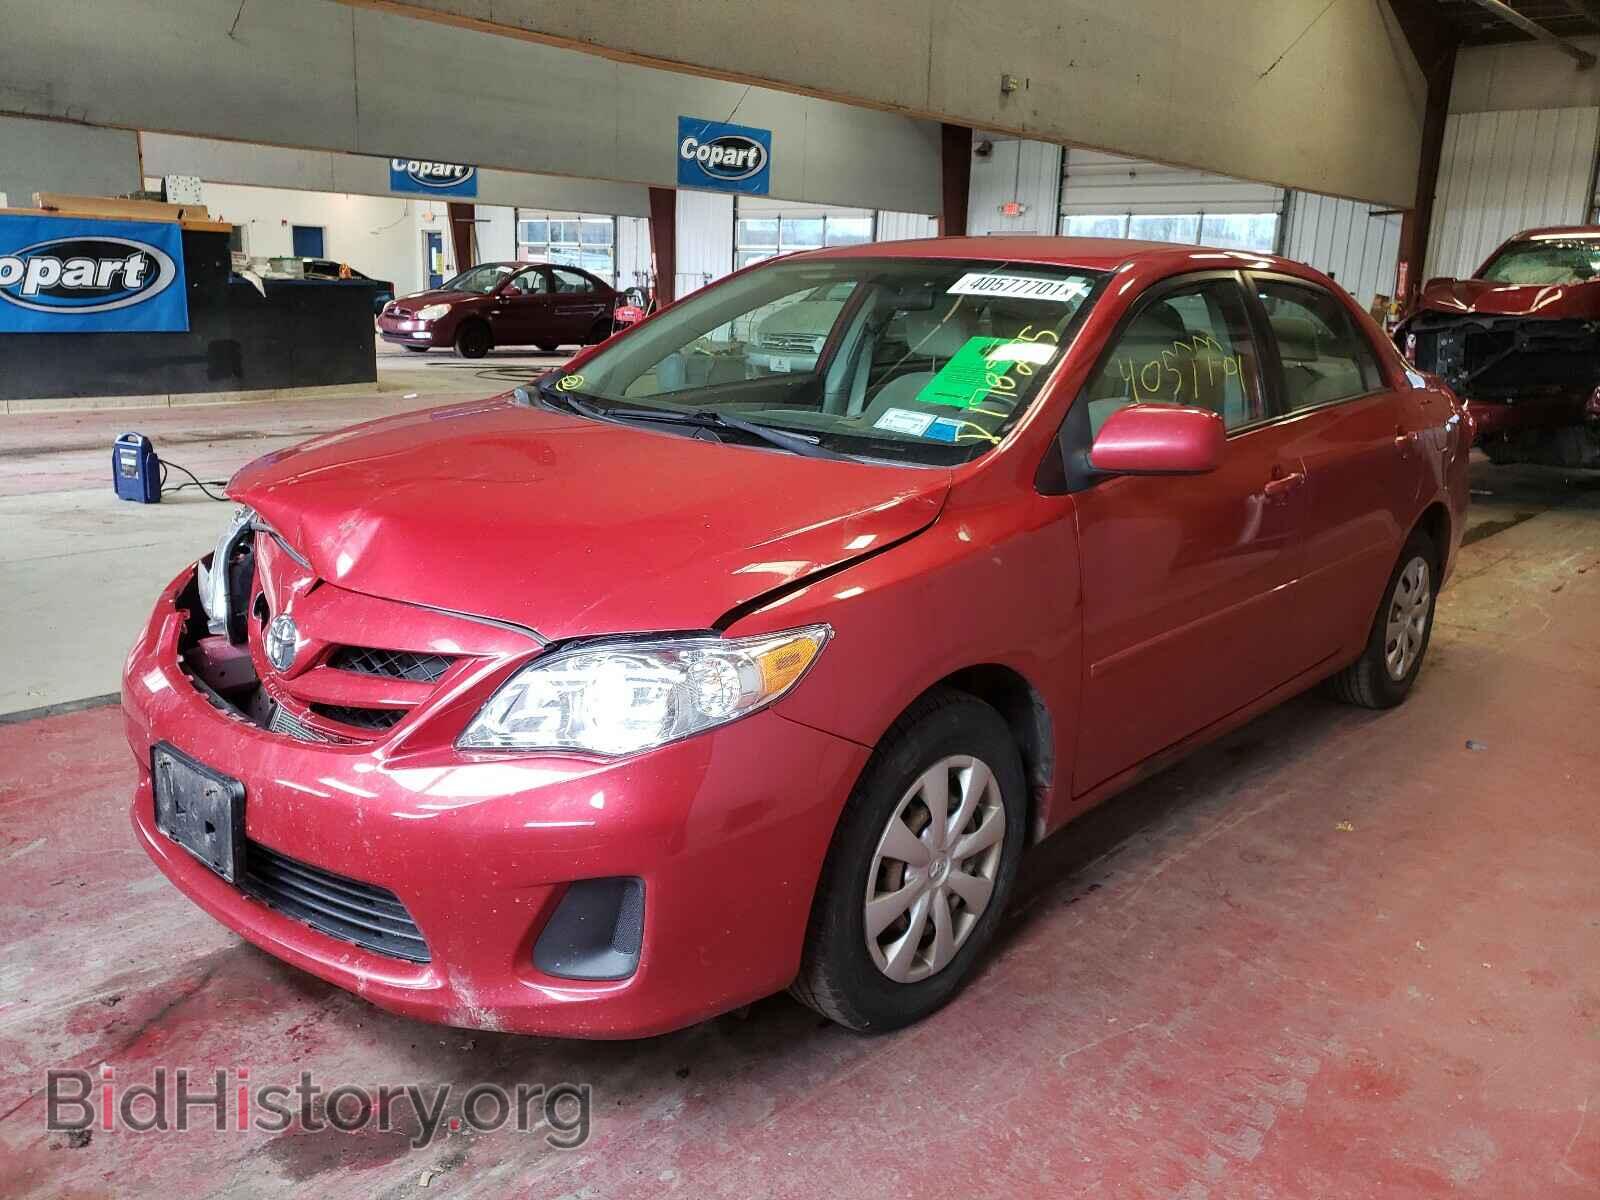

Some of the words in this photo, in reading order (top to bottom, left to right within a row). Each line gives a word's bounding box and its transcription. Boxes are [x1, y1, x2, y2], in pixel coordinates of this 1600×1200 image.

[680, 137, 758, 168] Copart
[0, 250, 148, 297] opart
[969, 276, 1064, 296] 40577701
